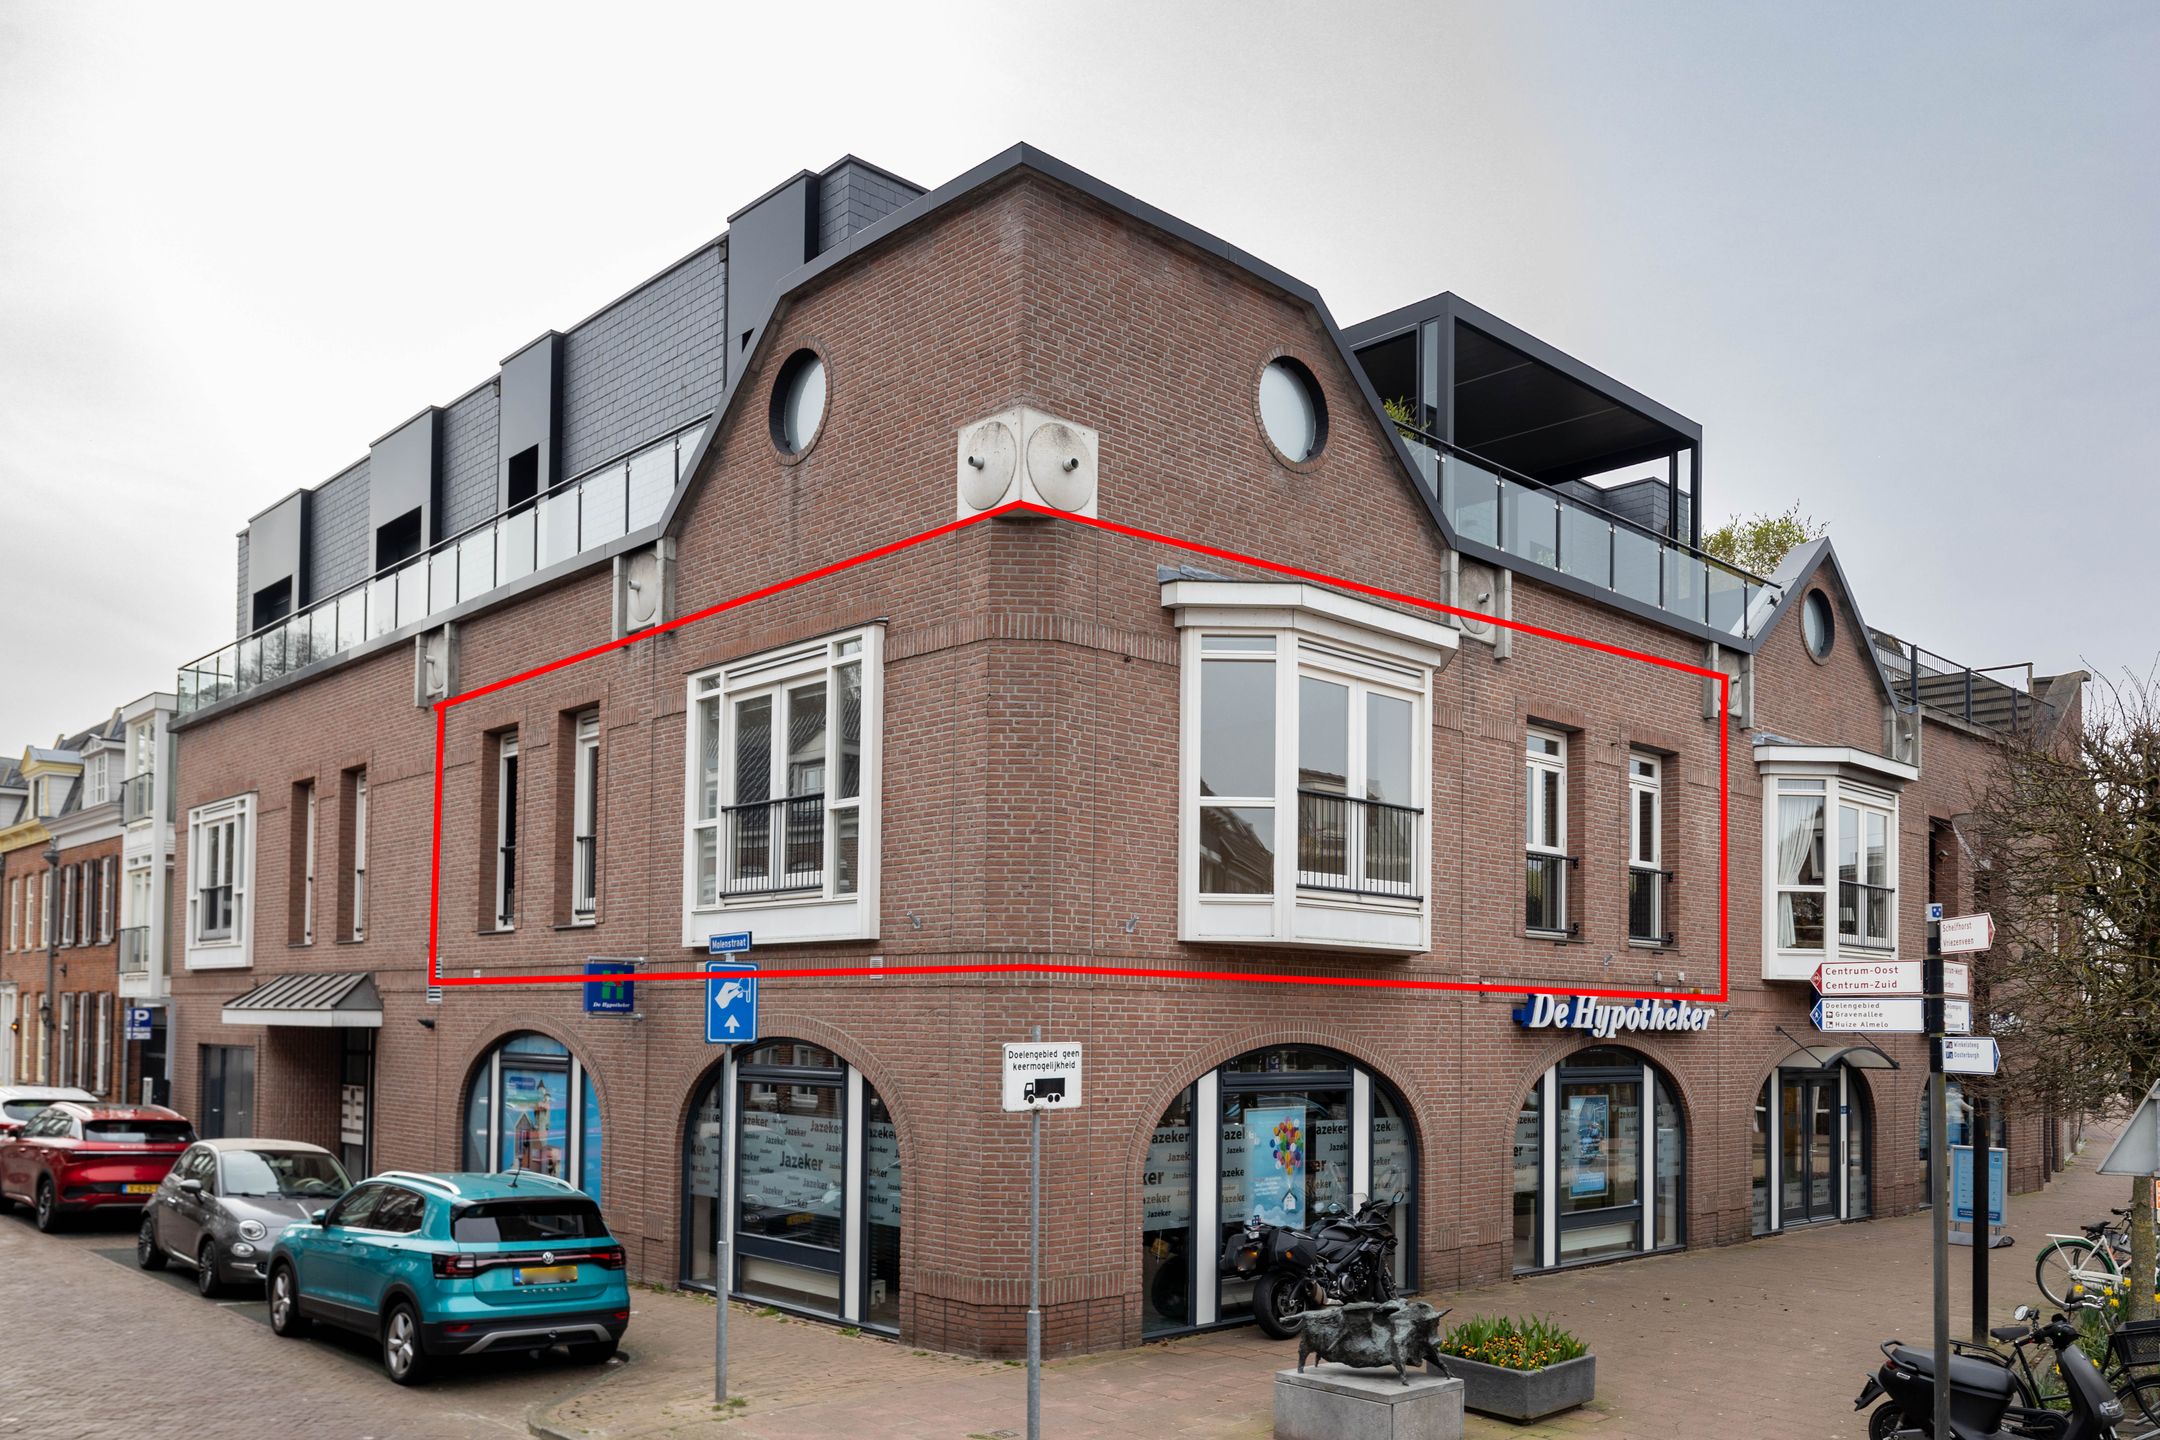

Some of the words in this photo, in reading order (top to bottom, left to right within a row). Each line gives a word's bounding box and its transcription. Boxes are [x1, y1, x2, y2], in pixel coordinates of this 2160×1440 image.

[712, 938, 746, 949] Molenstraat
[1825, 966, 1899, 976] Centrum-Oost
[1825, 980, 1897, 990] Centrum-Zuid
[1825, 1002, 1880, 1010] Doelengebied
[1529, 993, 1570, 1029] De
[1570, 994, 1716, 1039] Hypotheker
[1008, 1050, 1058, 1060] Doelengebied
[1062, 1050, 1080, 1060] geen
[1013, 1061, 1076, 1072] keermogelijkheid
[743, 1114, 768, 1127] azeker
[784, 1126, 807, 1137] Jazeker
[1316, 1122, 1348, 1135] azeker
[765, 1136, 787, 1145] Jazeker
[1152, 1130, 1190, 1144] azeker
[1328, 1142, 1348, 1151] Jazek
[779, 1151, 824, 1172] Jazeker
[1168, 1151, 1190, 1162] Jazek
[1222, 1167, 1245, 1178] azeke
[802, 1178, 828, 1190] Jazeker
[1147, 1208, 1172, 1218] Jazeker
